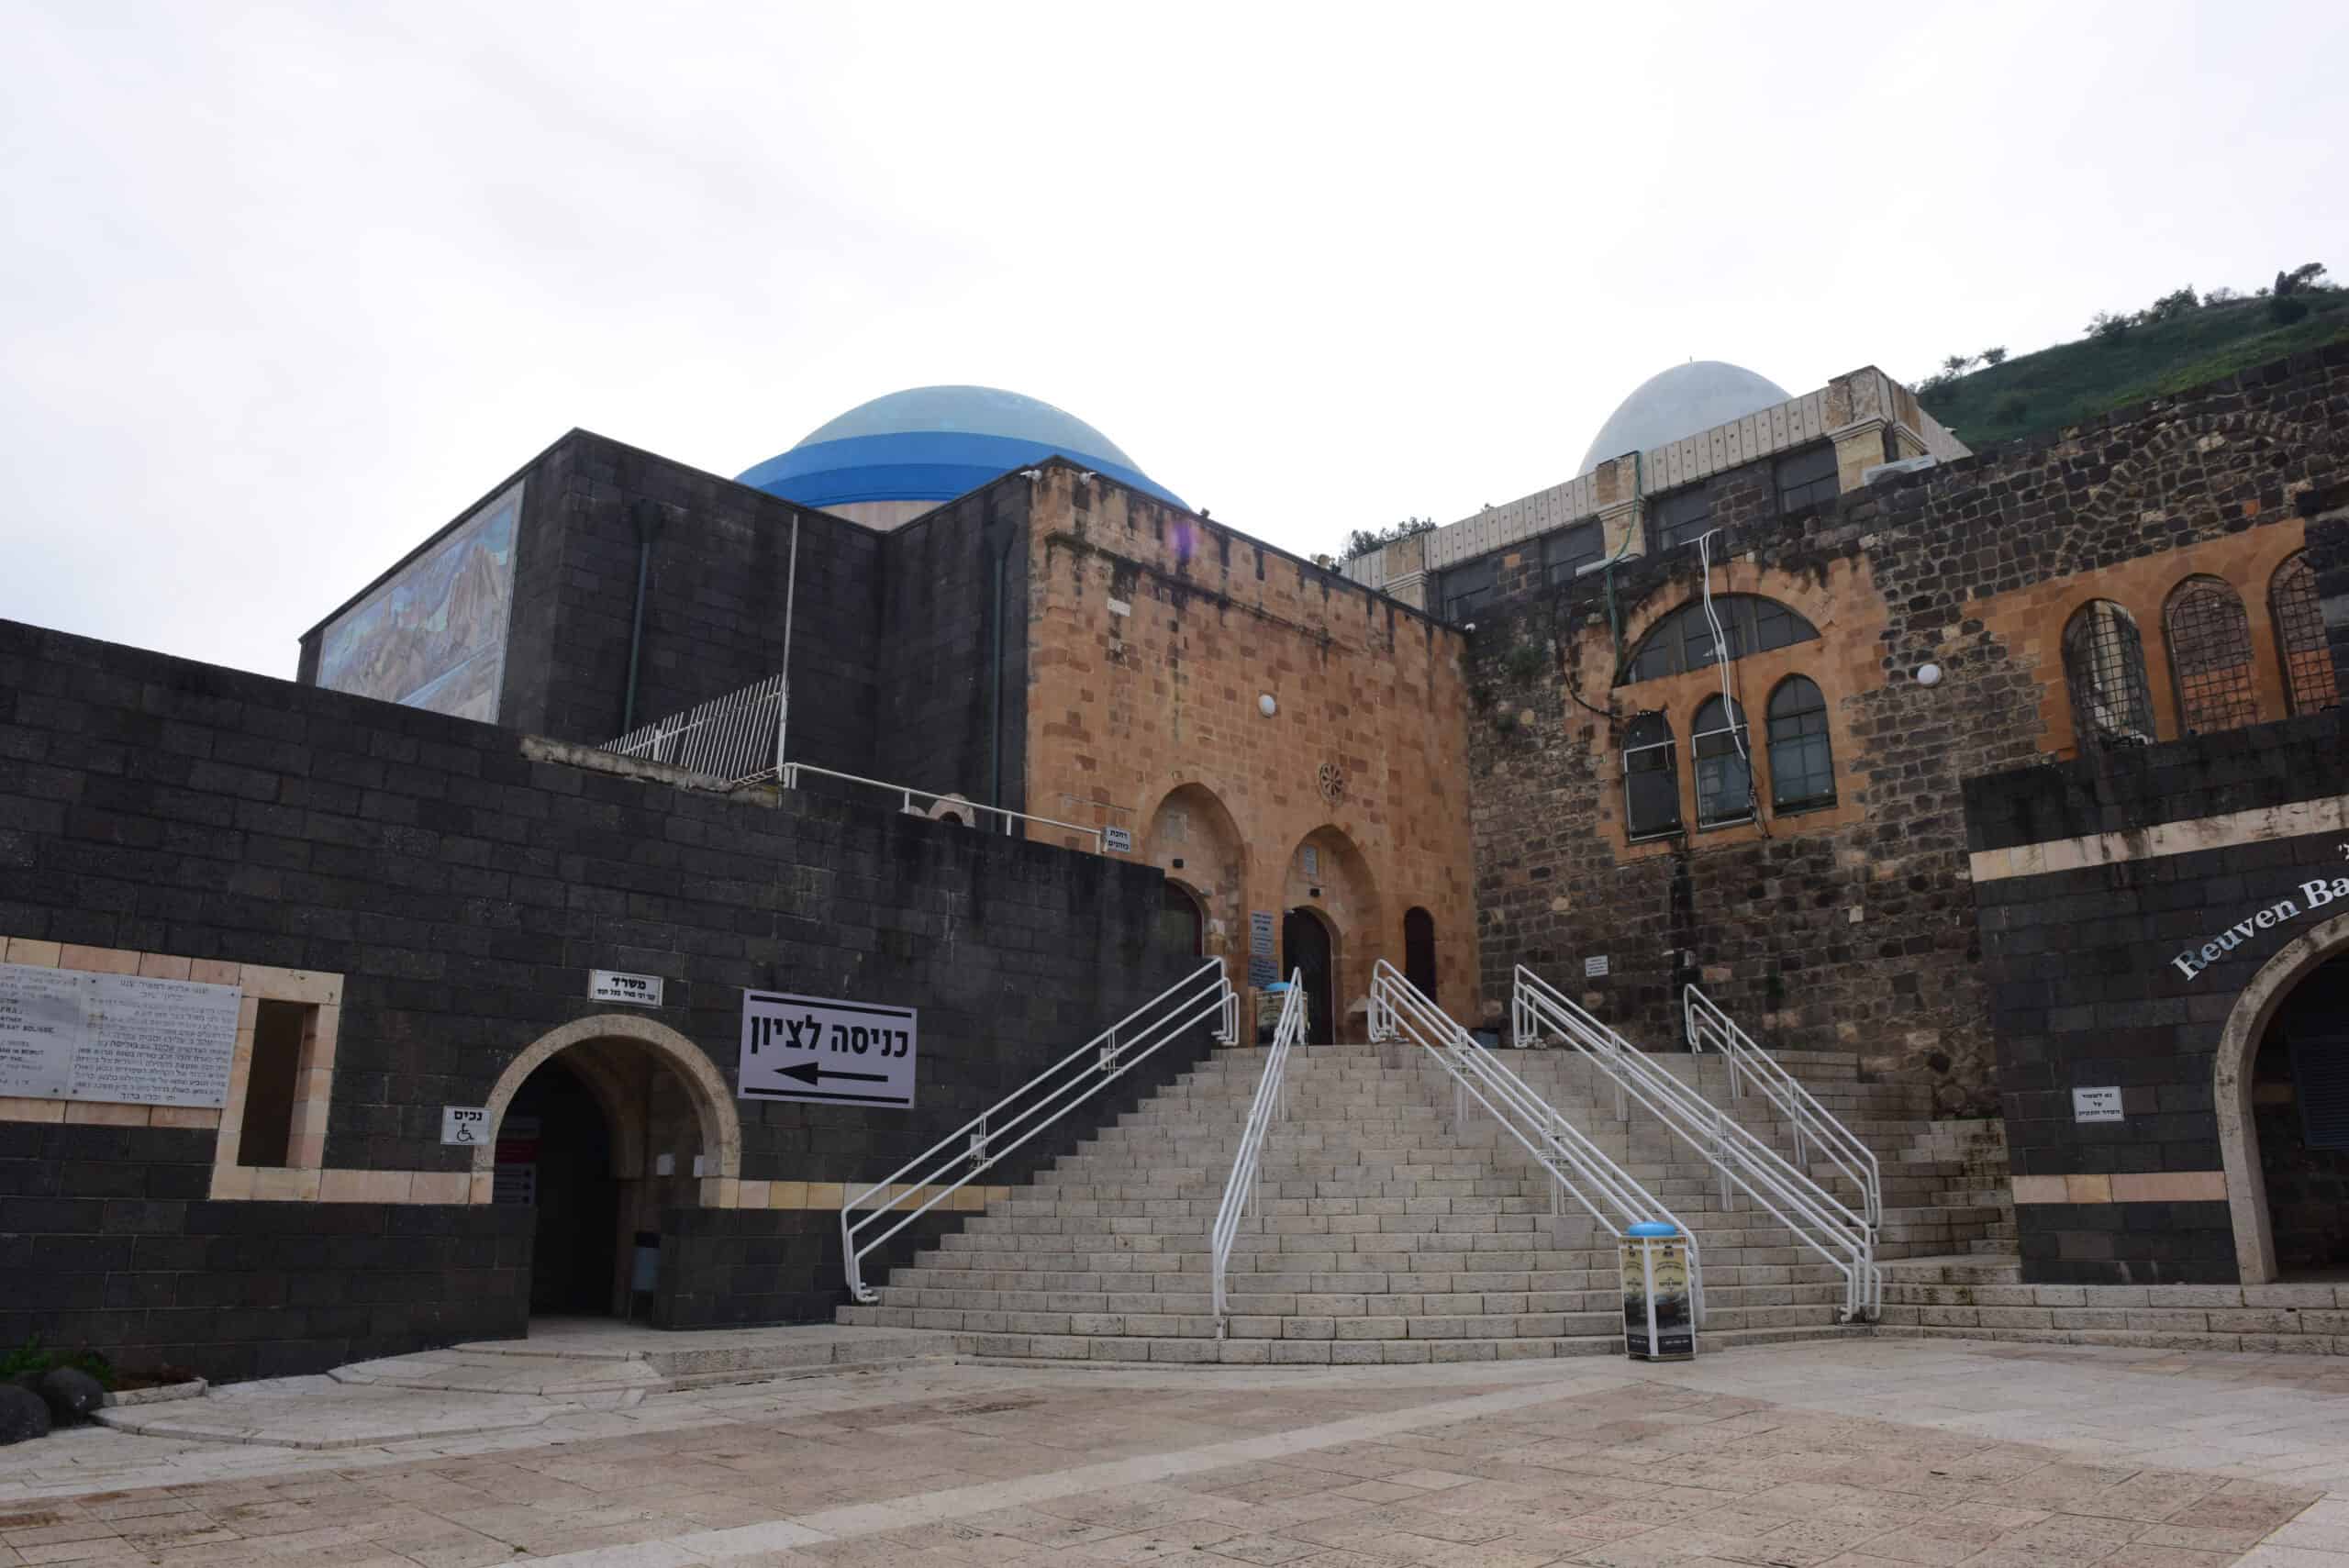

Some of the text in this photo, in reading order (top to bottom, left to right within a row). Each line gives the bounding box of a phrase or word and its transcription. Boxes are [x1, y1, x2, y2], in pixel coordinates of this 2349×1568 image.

[2171, 899, 2301, 981] Reuven
[611, 976, 647, 990] משרד
[751, 1014, 908, 1058] כניסה לציון
[454, 1110, 483, 1121] נכים
